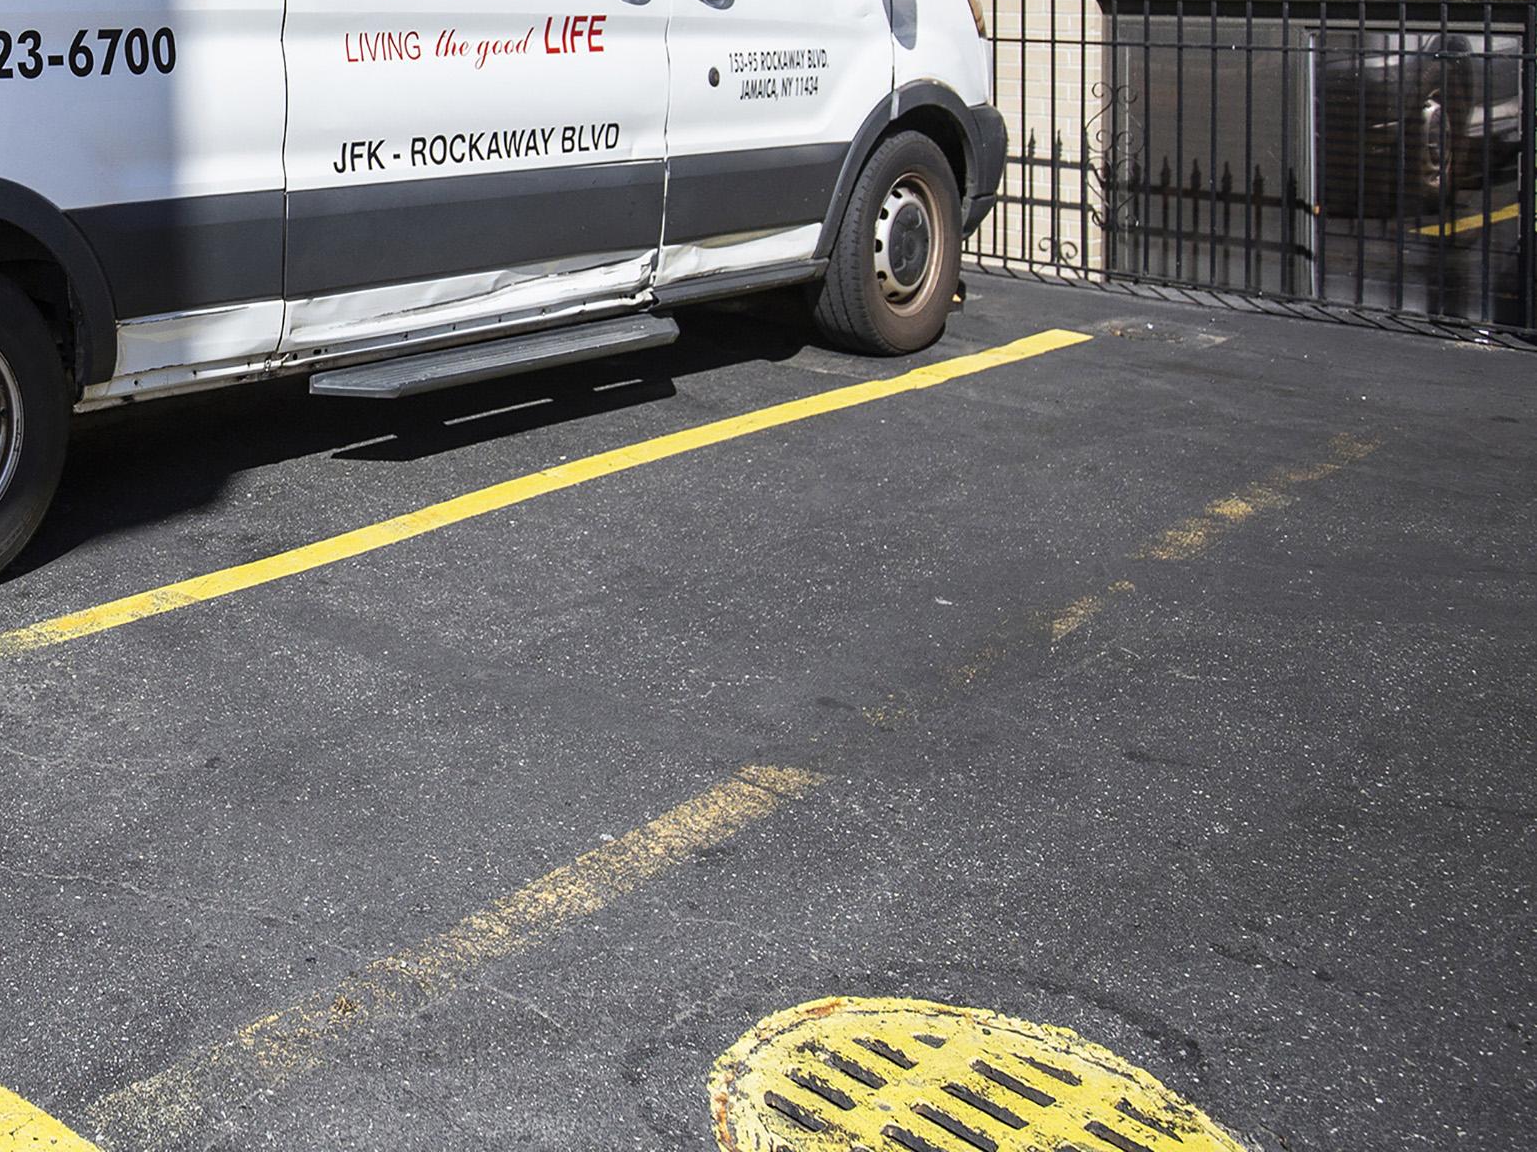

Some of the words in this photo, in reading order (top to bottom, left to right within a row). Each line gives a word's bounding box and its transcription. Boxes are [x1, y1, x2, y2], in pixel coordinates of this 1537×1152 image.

[346, 31, 421, 62] LIVING
[435, 29, 470, 57] the
[474, 27, 535, 70] good
[544, 15, 607, 54] LIFE
[729, 51, 758, 73] 153-95
[760, 49, 806, 71] ROCKAWAY
[740, 78, 778, 100] JAMAICA,
[781, 77, 794, 97] NY
[795, 76, 819, 97] 11434
[333, 140, 386, 173] JFK
[411, 127, 555, 167] ROCKAWAY
[561, 123, 620, 153] BLVD
